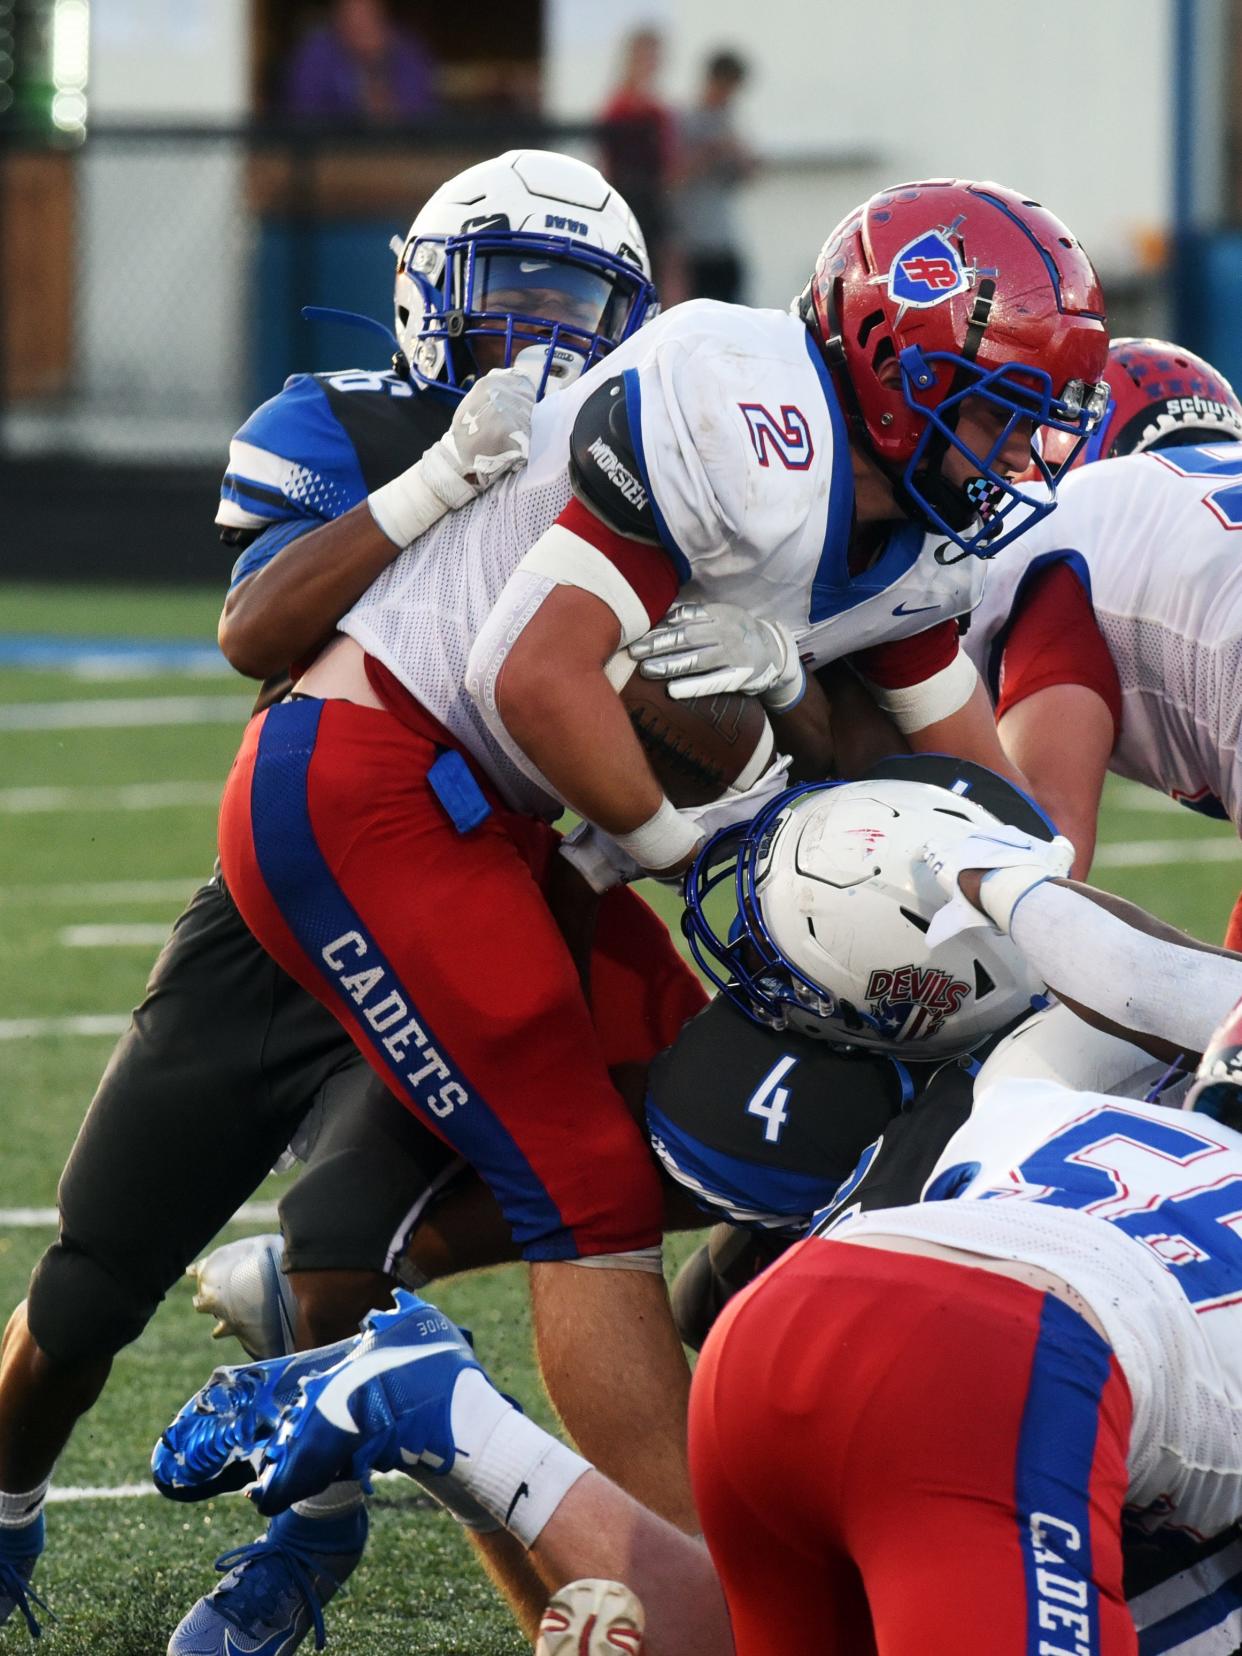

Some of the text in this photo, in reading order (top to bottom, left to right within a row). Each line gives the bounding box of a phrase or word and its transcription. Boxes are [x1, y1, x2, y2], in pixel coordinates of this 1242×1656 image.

[587, 436, 648, 511] MONSTER
[737, 402, 815, 471] 2
[321, 930, 469, 1118] CADETS
[864, 964, 971, 1018] DEVILS
[746, 1053, 799, 1143] 4
